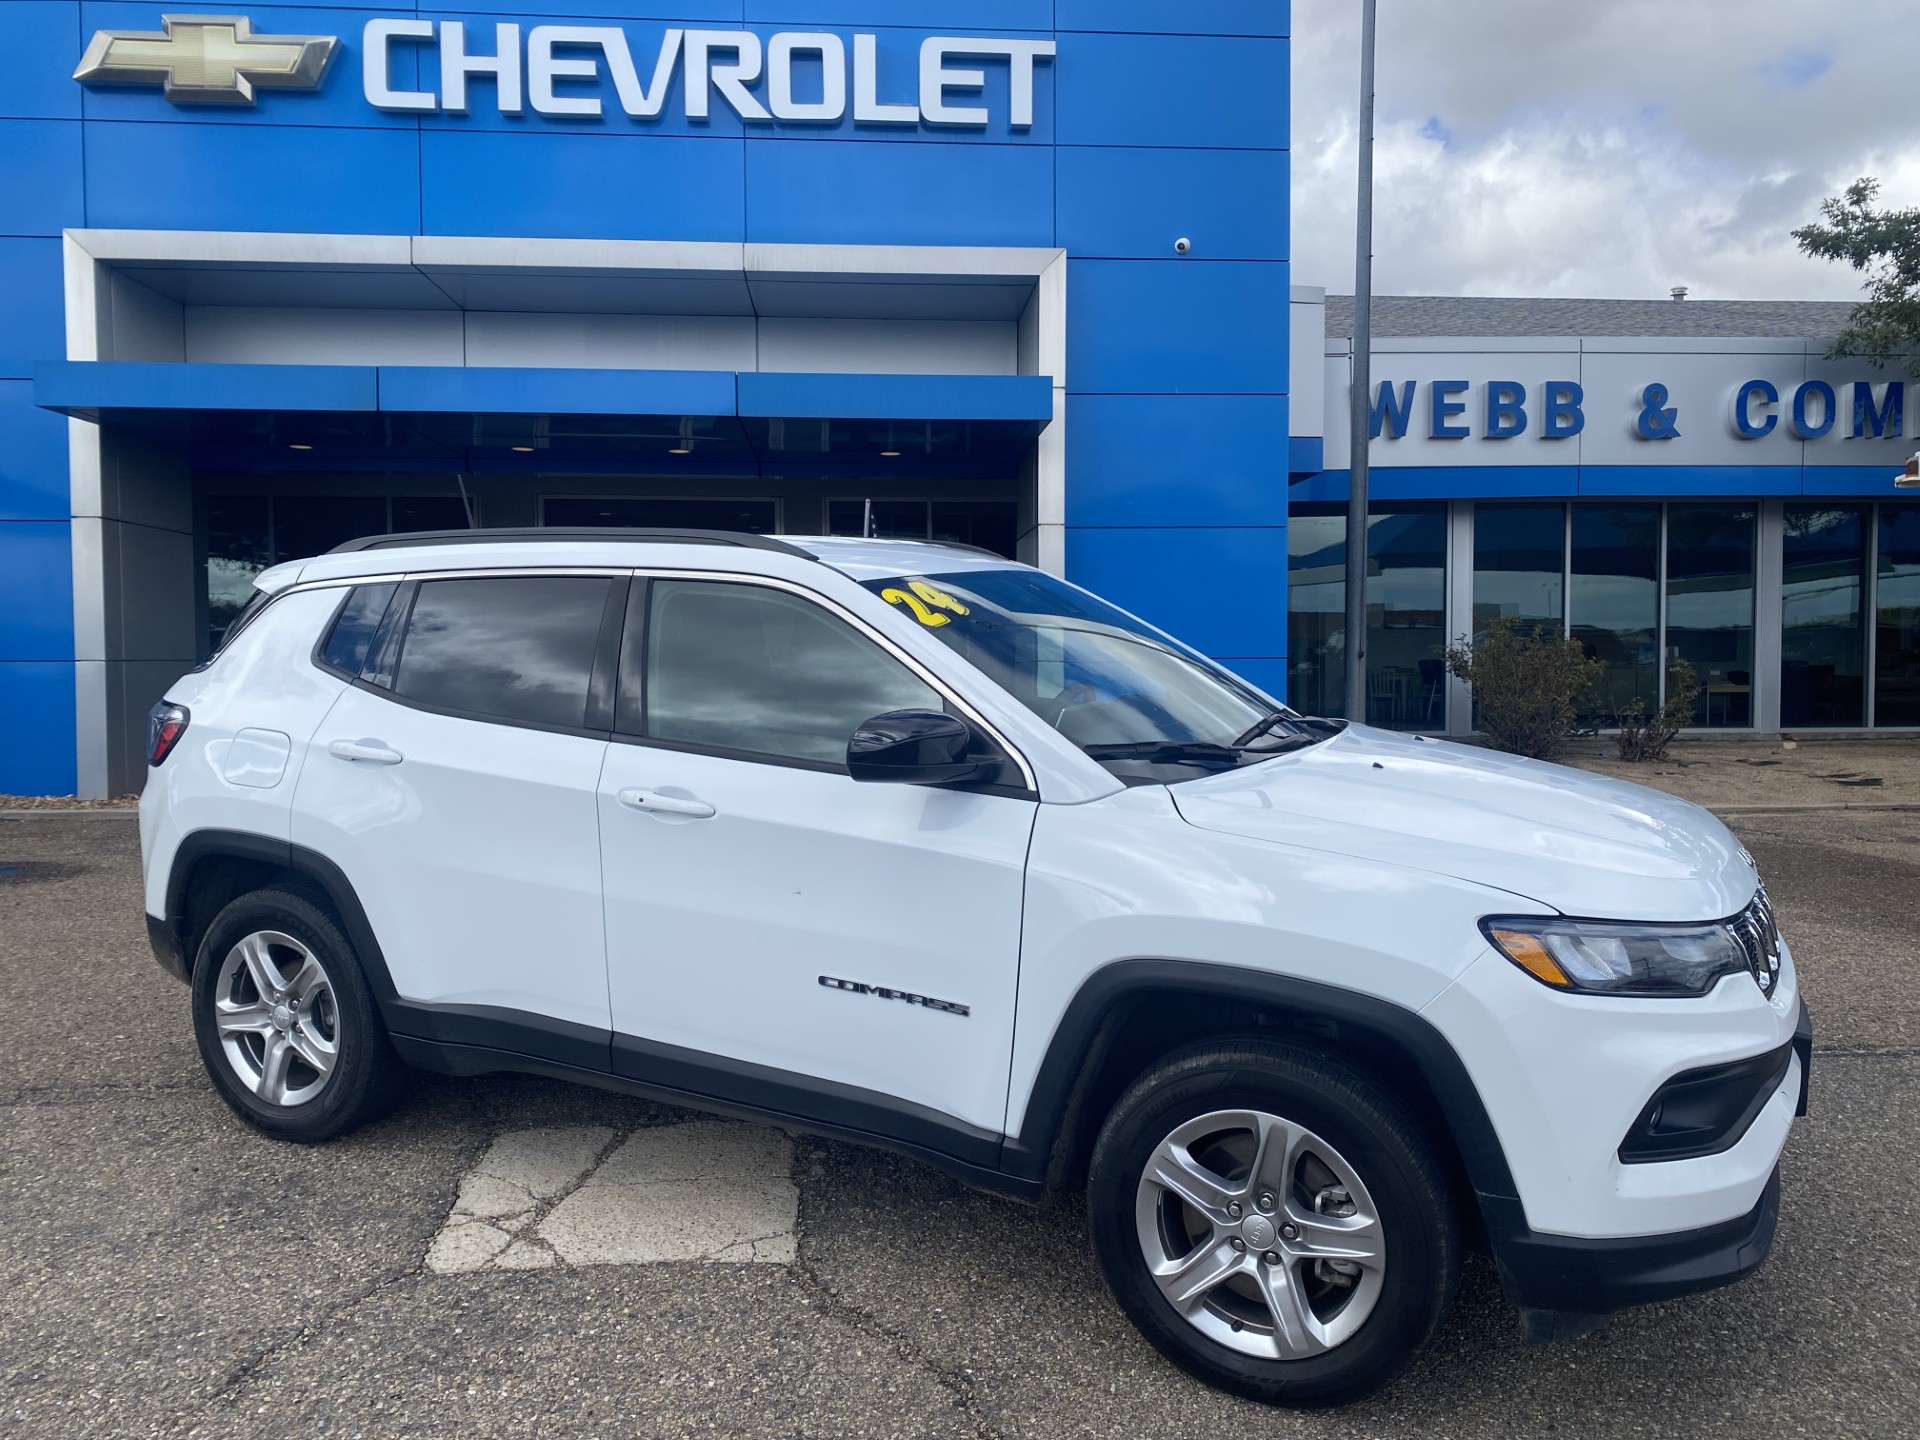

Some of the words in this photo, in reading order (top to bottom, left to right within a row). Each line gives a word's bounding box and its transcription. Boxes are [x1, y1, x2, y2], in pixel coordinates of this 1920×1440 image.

[362, 17, 1056, 130] CHEVROLET
[1368, 380, 1585, 439] WEBB
[1635, 382, 1682, 440] &
[1729, 379, 1920, 440] COM
[881, 581, 970, 627] 24
[818, 975, 970, 1017] COMPASS
